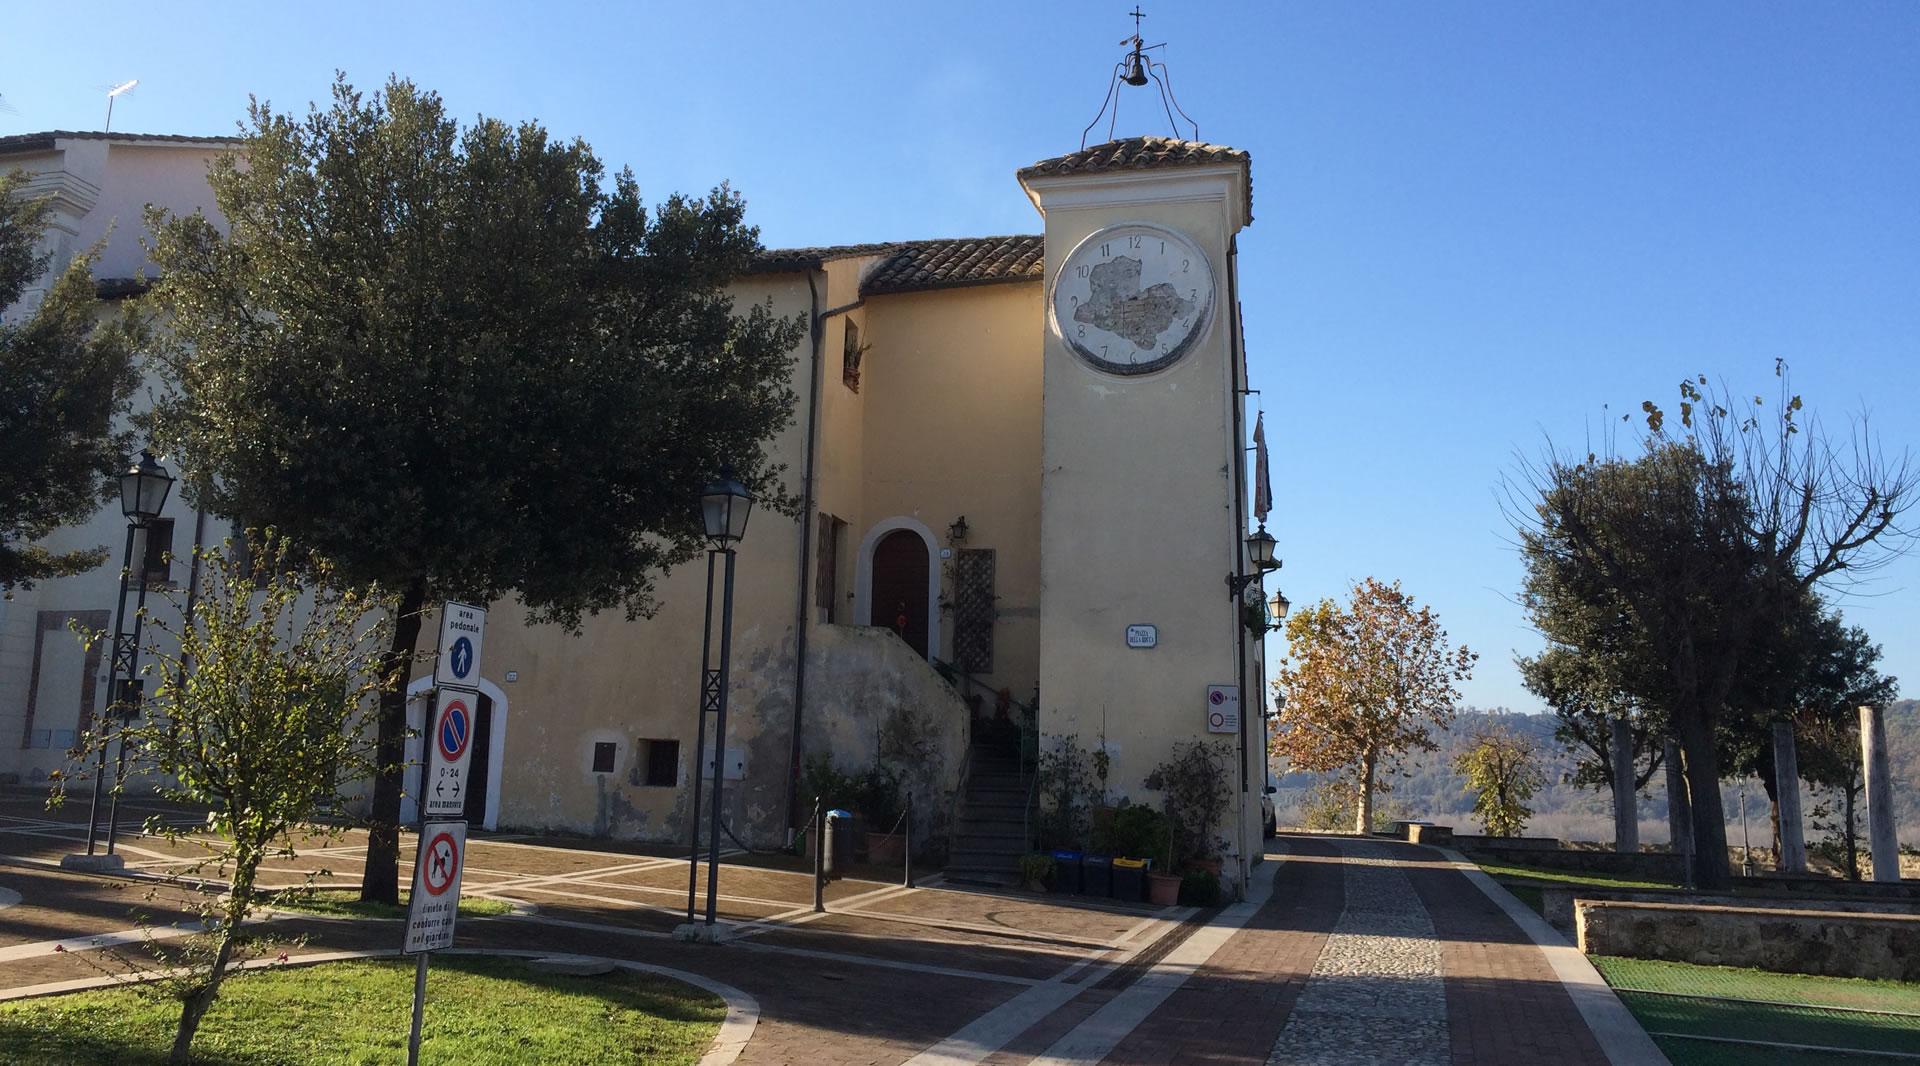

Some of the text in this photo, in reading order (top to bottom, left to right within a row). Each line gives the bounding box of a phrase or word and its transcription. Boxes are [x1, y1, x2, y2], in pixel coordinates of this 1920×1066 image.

[1129, 236, 1141, 249] 12
[1161, 242, 1165, 255] 1
[1101, 243, 1110, 257] 11
[1076, 264, 1090, 278] 10
[1183, 259, 1190, 273] 2
[1190, 289, 1198, 302] 3
[1182, 318, 1189, 329] 4
[1077, 324, 1086, 338] 8
[1101, 345, 1108, 358] 7
[1161, 343, 1169, 355] 5
[1129, 351, 1137, 363] 6
[459, 610, 473, 620] area
[450, 621, 479, 633] pedonale
[429, 800, 441, 809] area
[422, 902, 442, 914] divieto
[412, 917, 440, 929] condurre
[412, 932, 424, 945] nel
